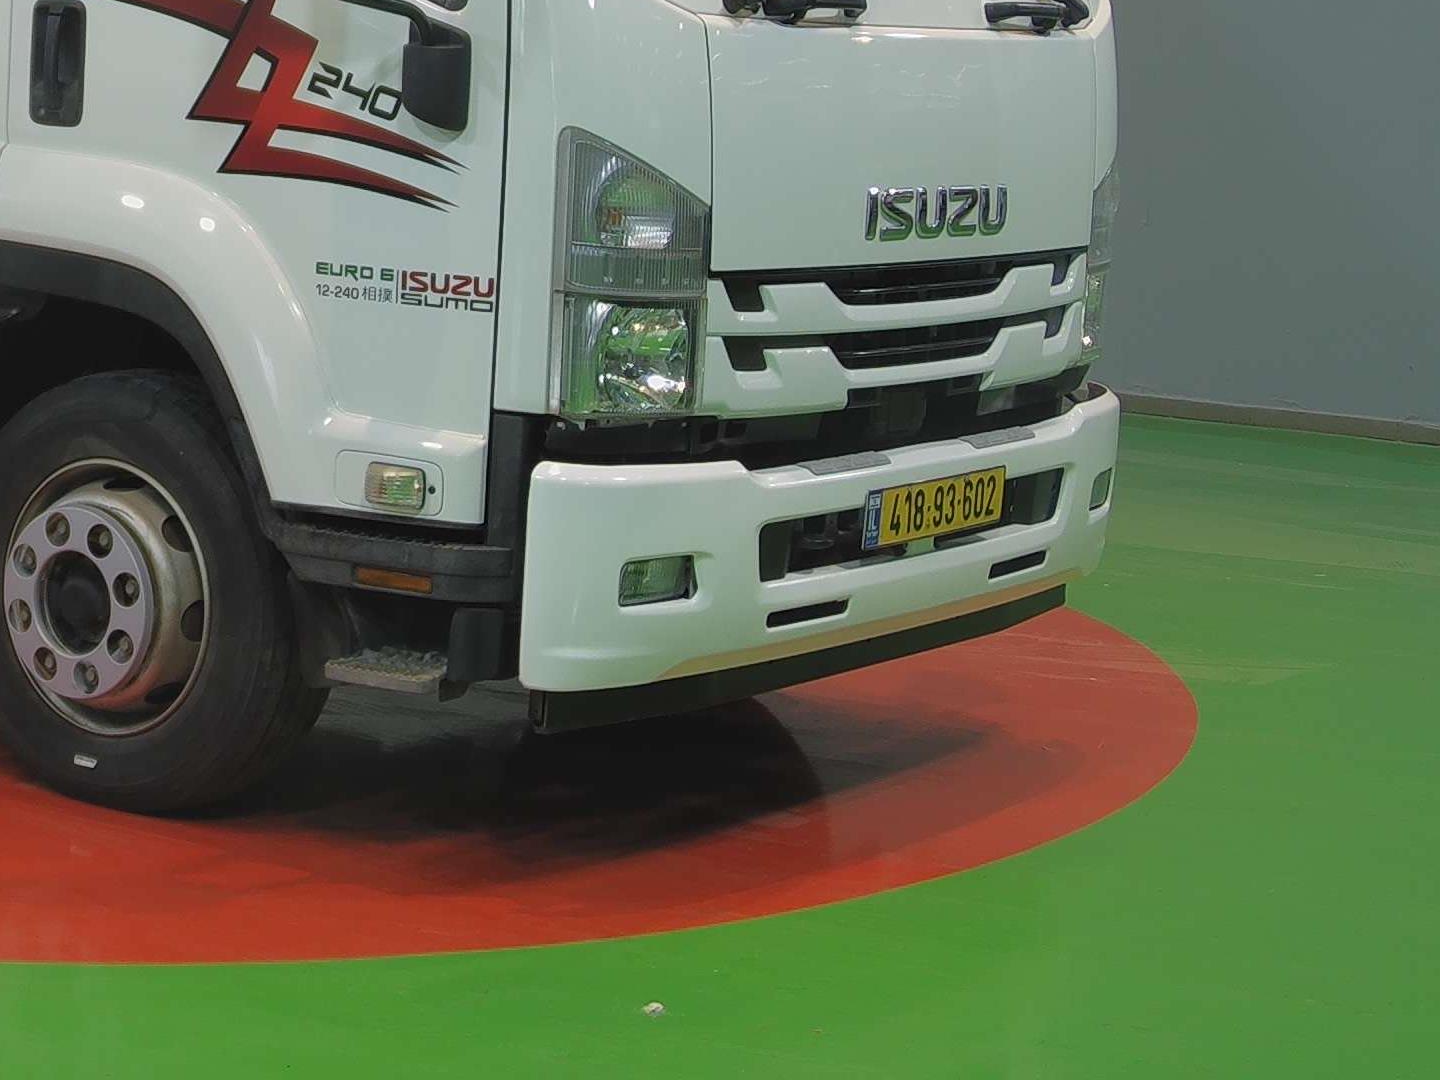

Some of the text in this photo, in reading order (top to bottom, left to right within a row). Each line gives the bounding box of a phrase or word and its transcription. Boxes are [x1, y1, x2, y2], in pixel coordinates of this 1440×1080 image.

[307, 61, 402, 121] 240
[864, 184, 1007, 242] ISUZU
[315, 262, 395, 282] EURO 6
[400, 270, 495, 299] ISUZU
[315, 284, 359, 301] 12-240
[399, 292, 494, 313] SUMO
